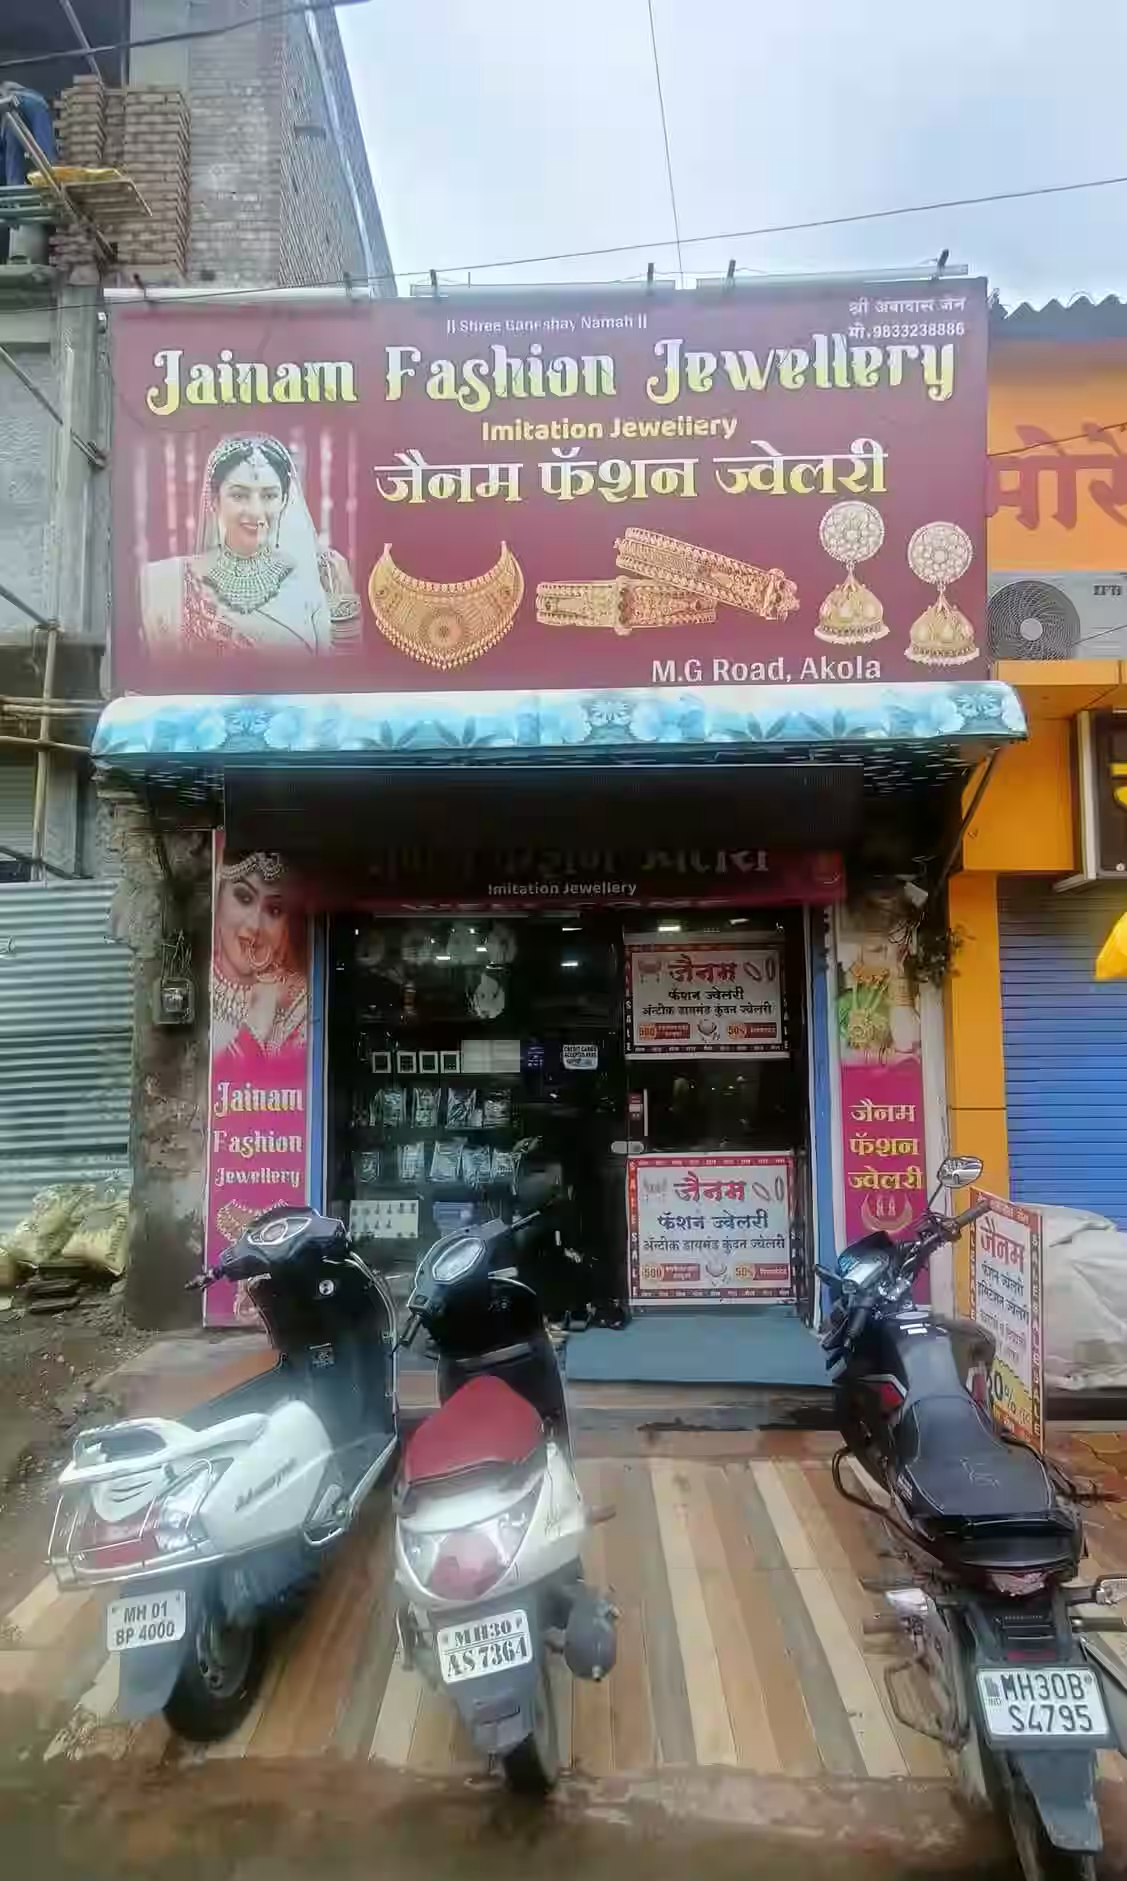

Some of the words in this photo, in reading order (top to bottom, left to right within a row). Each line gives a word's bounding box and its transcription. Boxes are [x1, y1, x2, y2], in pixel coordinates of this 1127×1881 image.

[460, 319, 501, 333] Shree
[581, 314, 634, 329] Namah
[146, 348, 359, 417] Jainam
[385, 343, 617, 413] Fashion
[646, 333, 955, 405] Jewellery
[481, 419, 602, 441] Imitation
[609, 415, 738, 442] Jewellery
[373, 449, 523, 504] जैनम
[713, 438, 889, 497] ज्वेलरी
[651, 659, 703, 683] M.G
[712, 657, 792, 685] Road,
[800, 656, 882, 681] Akola
[488, 883, 559, 897] Imitation
[562, 881, 637, 898] Jewellery
[668, 953, 738, 984] जैनम
[704, 984, 745, 1001] ज्वेलरी
[214, 1081, 305, 1117] Jainam
[848, 1098, 916, 1123] जैनम
[213, 1129, 304, 1159] Fashion
[850, 1132, 920, 1156] फॅशन
[214, 1166, 301, 1188] Jewellery
[672, 1170, 748, 1203] जैनम
[848, 1165, 924, 1190] ज्वेलरी
[657, 1210, 705, 1230] फॅशन
[711, 1208, 769, 1230] ज्वेलरी
[979, 1213, 1026, 1274] जैनम
[124, 1605, 147, 1624] MH
[151, 1600, 168, 1619] 01
[116, 1627, 138, 1647] BP
[138, 1620, 175, 1642] 4000
[454, 1618, 512, 1649] MH30
[1001, 1673, 1085, 1700] MH30B
[1008, 1704, 1093, 1733] S4795
